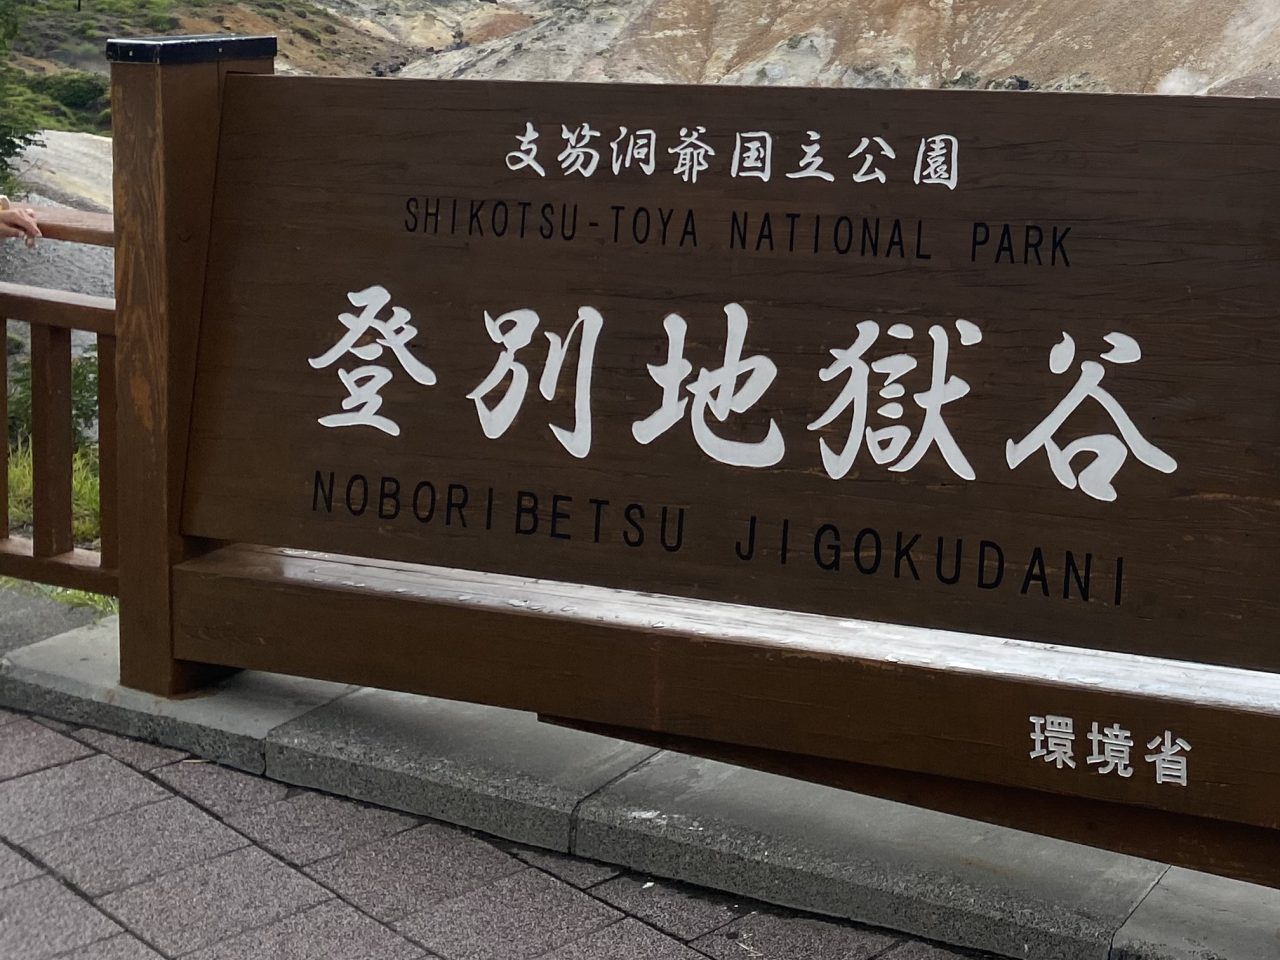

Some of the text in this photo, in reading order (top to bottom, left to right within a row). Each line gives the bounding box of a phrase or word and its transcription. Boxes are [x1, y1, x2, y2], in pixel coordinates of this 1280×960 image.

[504, 120, 960, 191] 支笏洞爺国立公園
[404, 196, 1073, 269] SHIKOTSU-TOYA NATIONAL PARK
[308, 285, 1178, 502] 登別地獄谷
[311, 469, 1125, 607] NOBORIBETSU JIGOKUDANI
[1029, 713, 1192, 787] 環境省
